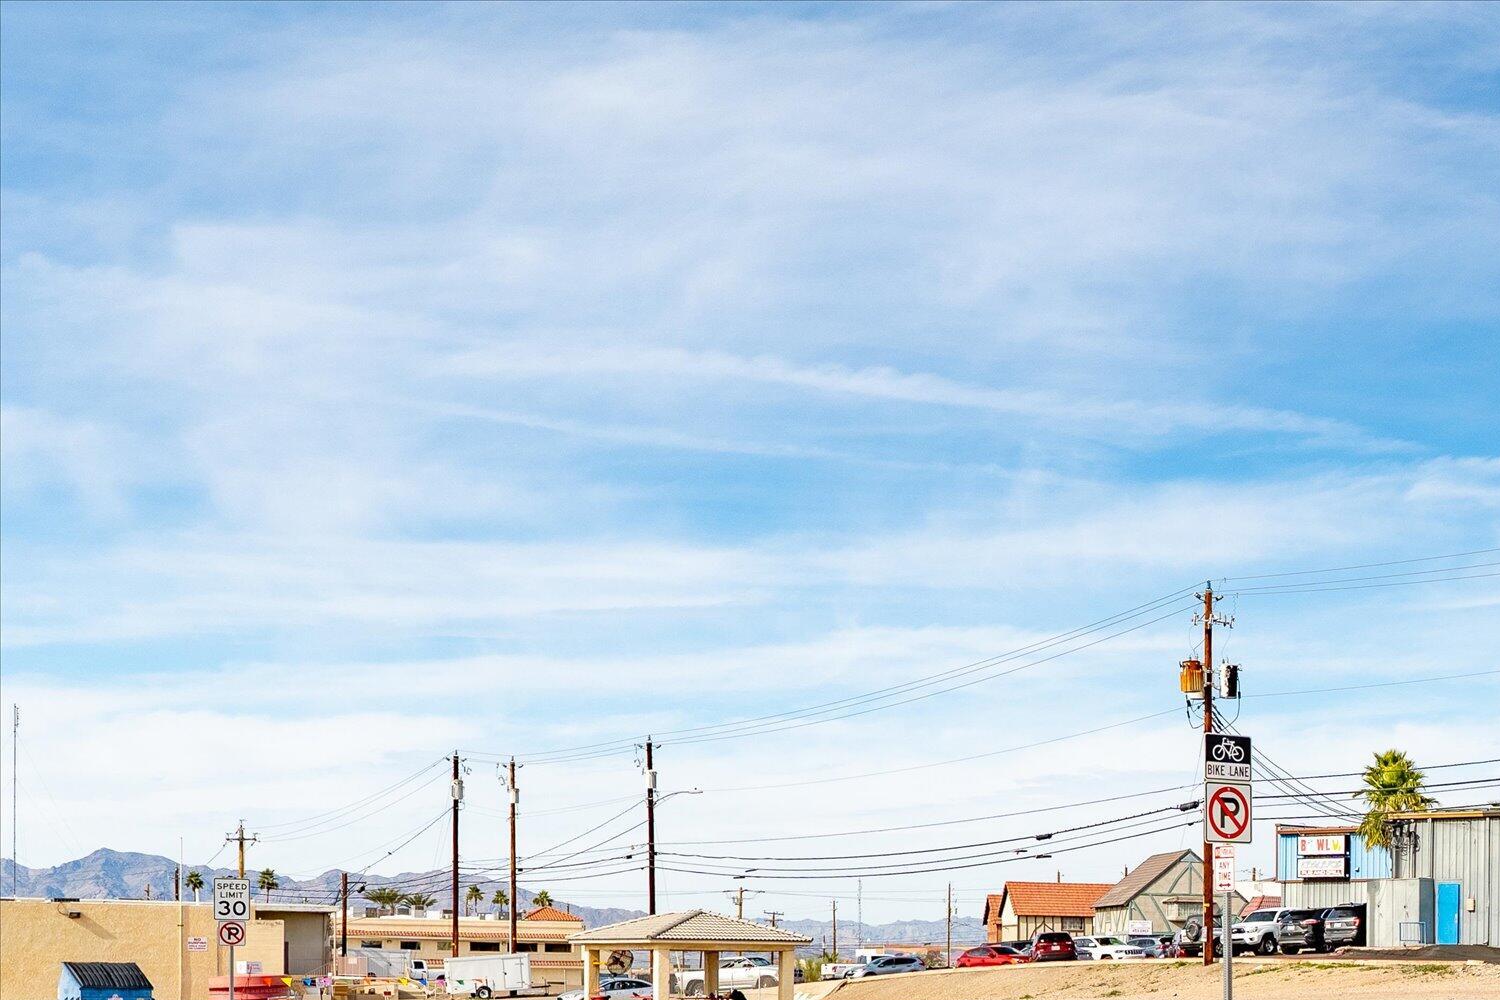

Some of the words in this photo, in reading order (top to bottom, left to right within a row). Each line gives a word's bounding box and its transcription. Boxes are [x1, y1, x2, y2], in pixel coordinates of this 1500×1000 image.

[1207, 764, 1225, 776] BIKE
[1229, 765, 1249, 778] LANE
[1218, 871, 1231, 881] TIME
[217, 883, 248, 891] SPEED
[218, 900, 247, 916] 30
